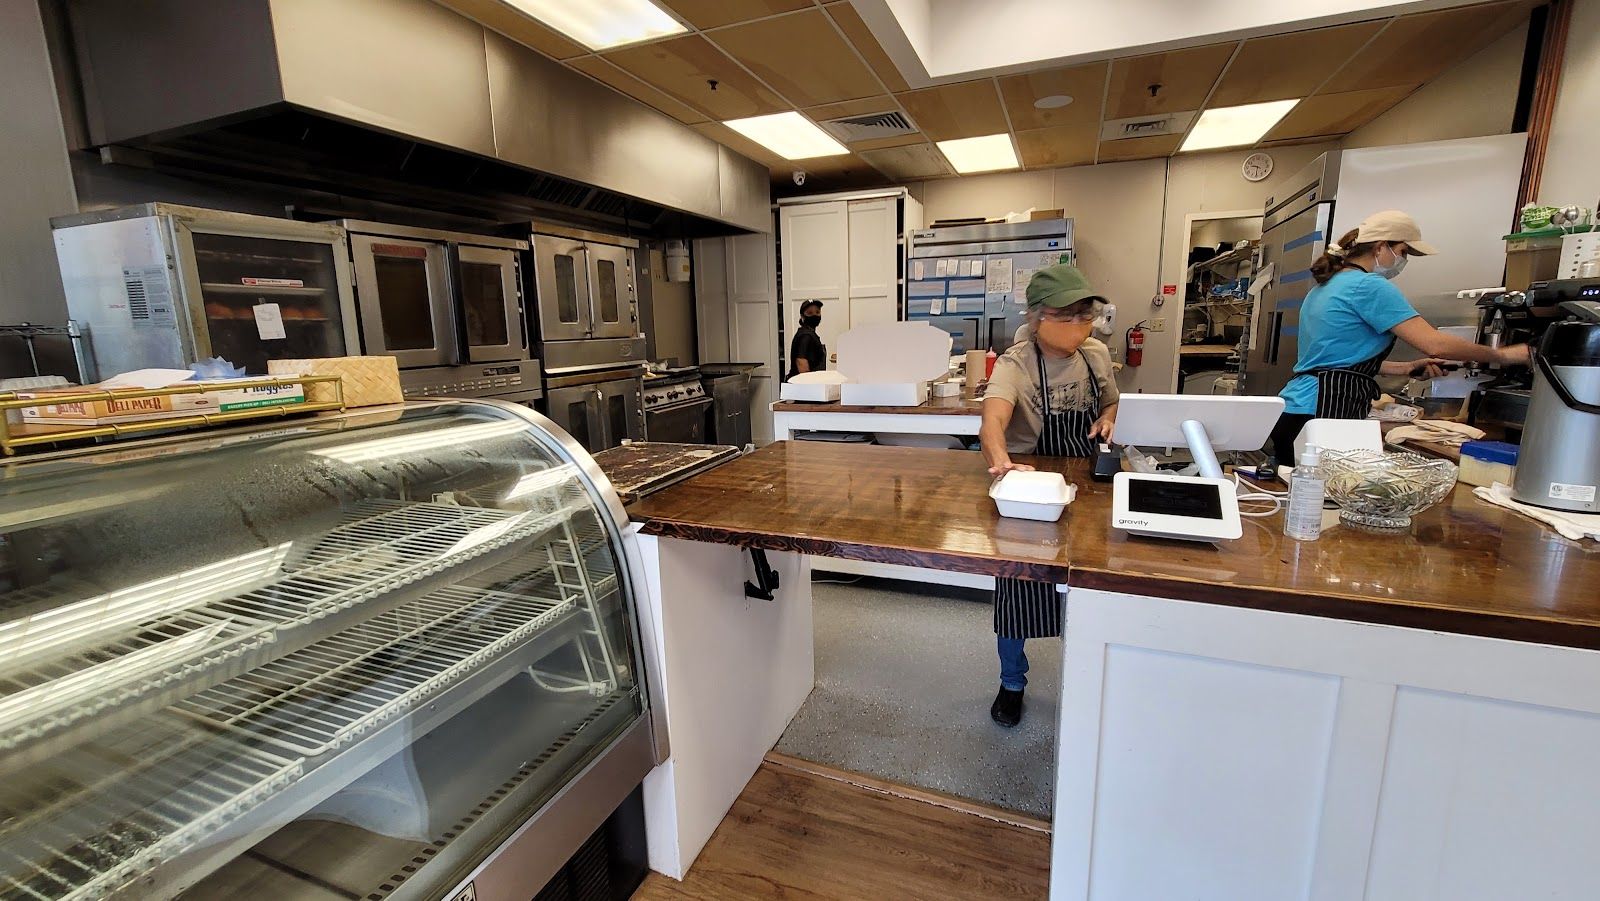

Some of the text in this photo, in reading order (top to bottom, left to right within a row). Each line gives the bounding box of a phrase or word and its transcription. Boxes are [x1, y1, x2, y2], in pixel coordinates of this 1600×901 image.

[107, 397, 161, 414] DELI PAPER
[1118, 518, 1149, 527] gravity
